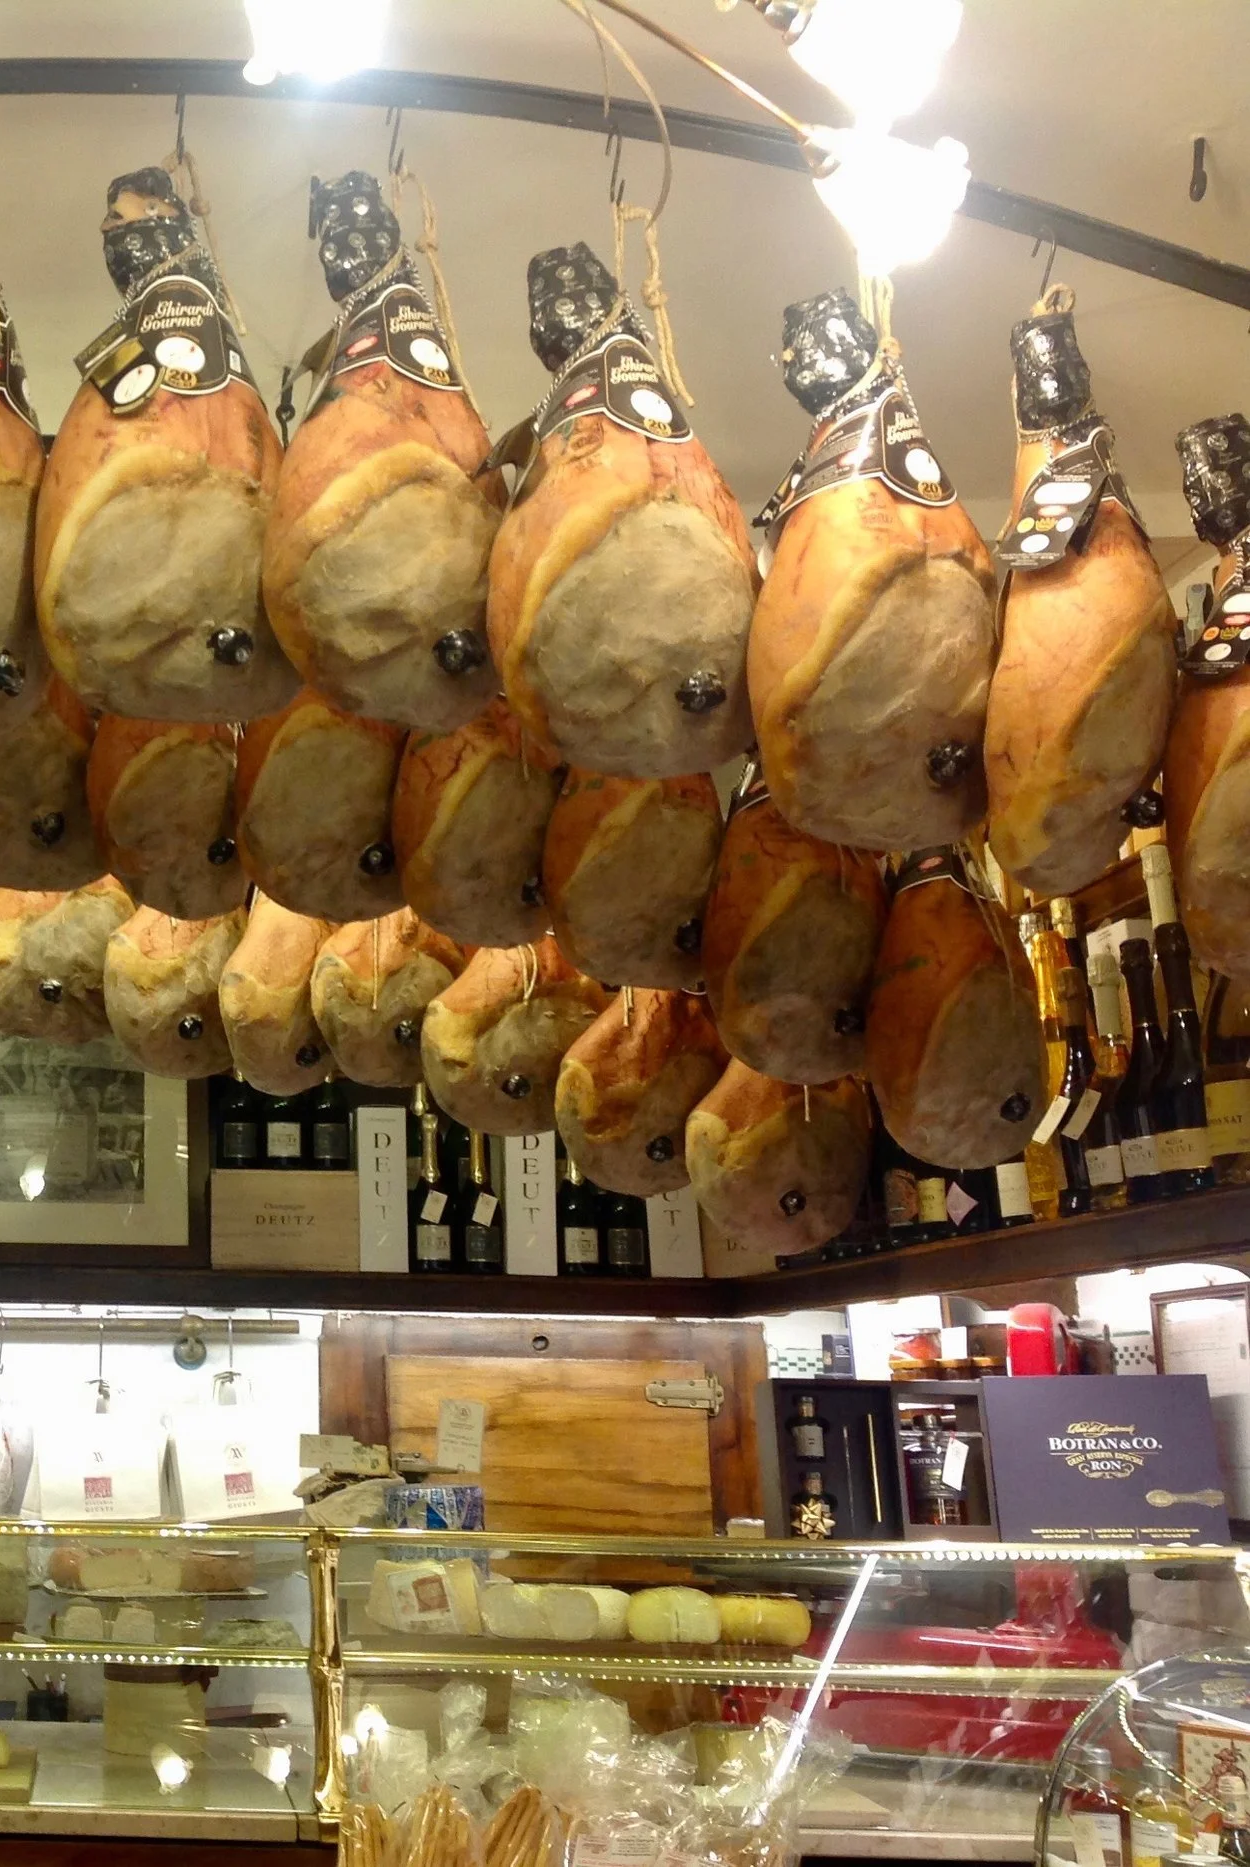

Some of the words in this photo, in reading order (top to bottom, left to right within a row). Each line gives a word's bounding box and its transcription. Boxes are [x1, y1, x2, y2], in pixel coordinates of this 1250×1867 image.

[155, 301, 215, 319] Ghirardi
[140, 314, 203, 333] Gourmet
[169, 369, 192, 382] 20
[921, 482, 939, 494] 20
[373, 1132, 392, 1248] DEUTZ
[521, 1135, 541, 1249] DEUTZ
[255, 1215, 316, 1226] DEUTZ
[1048, 1437, 1119, 1450] BOTRAN
[1090, 1460, 1123, 1471] RON
